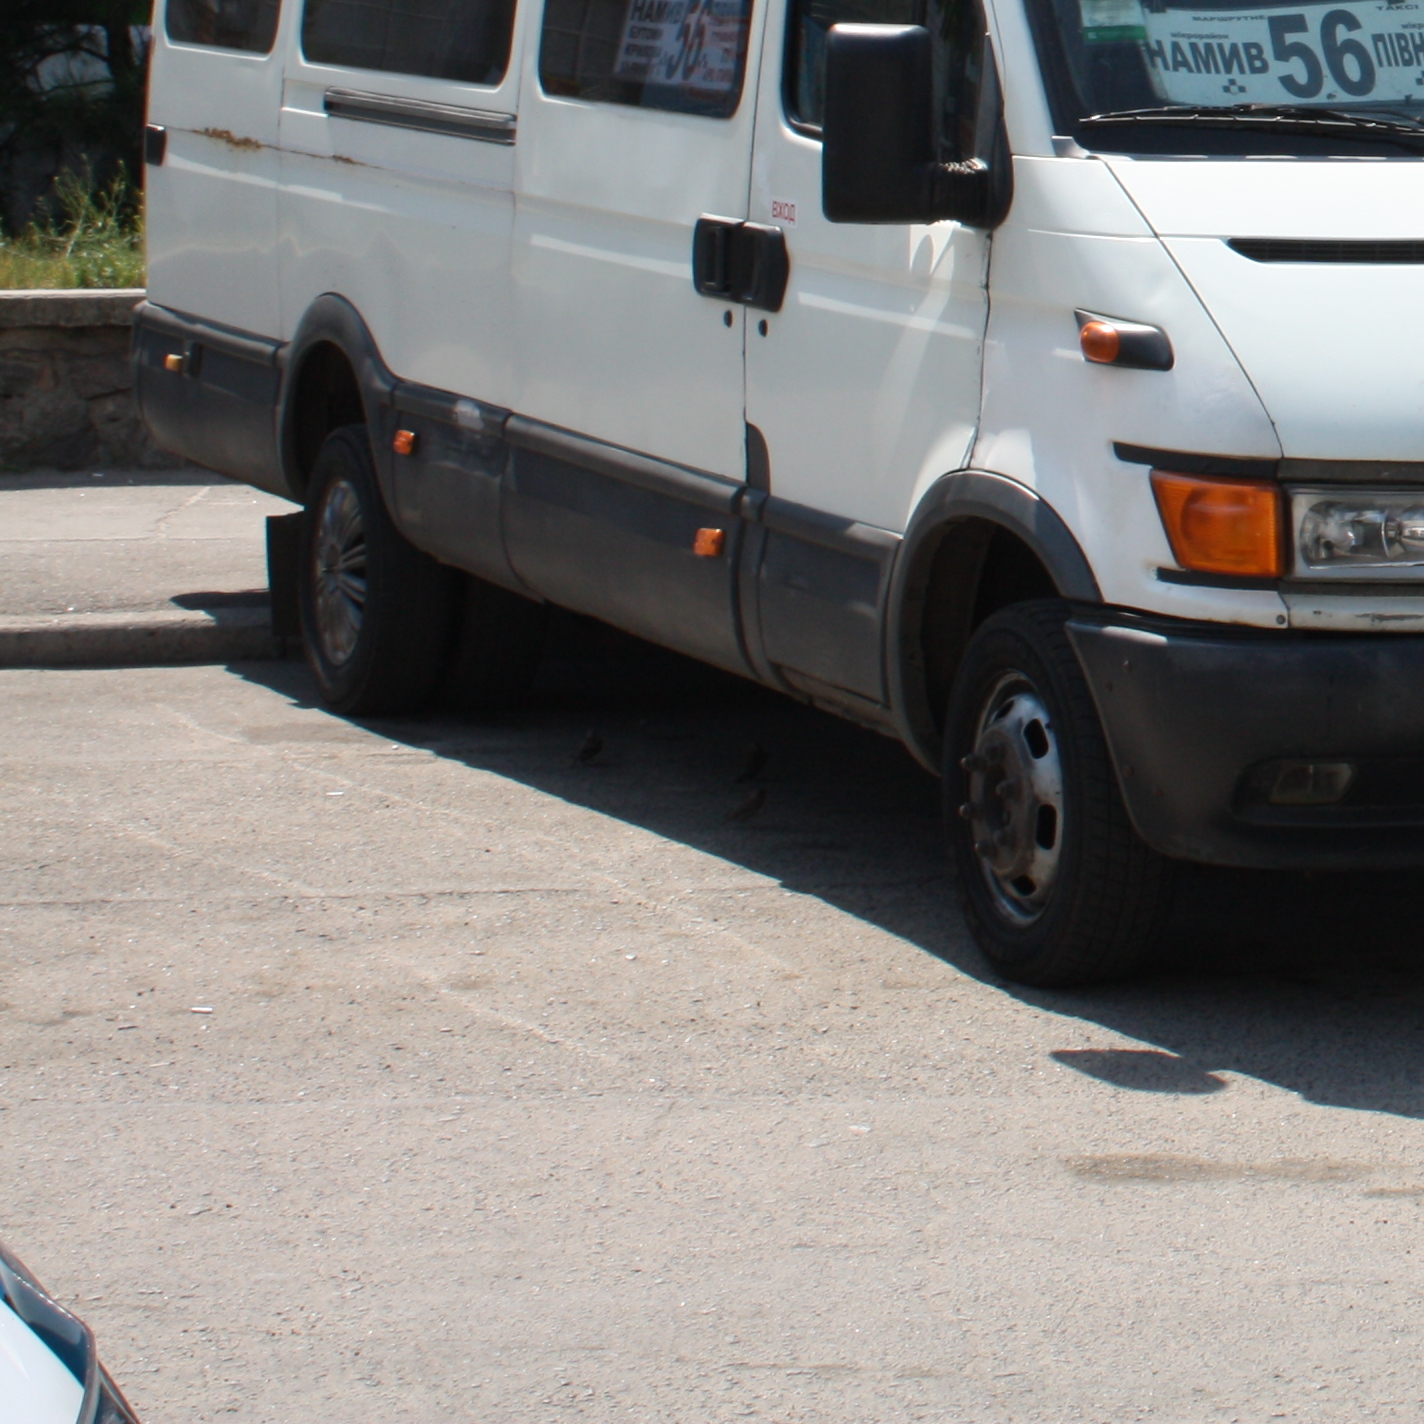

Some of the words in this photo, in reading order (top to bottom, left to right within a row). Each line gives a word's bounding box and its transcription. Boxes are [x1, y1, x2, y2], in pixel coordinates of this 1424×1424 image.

[1147, 39, 1270, 76] НАМИВ
[1267, 9, 1376, 99] 56
[771, 200, 797, 223] ВХОД
